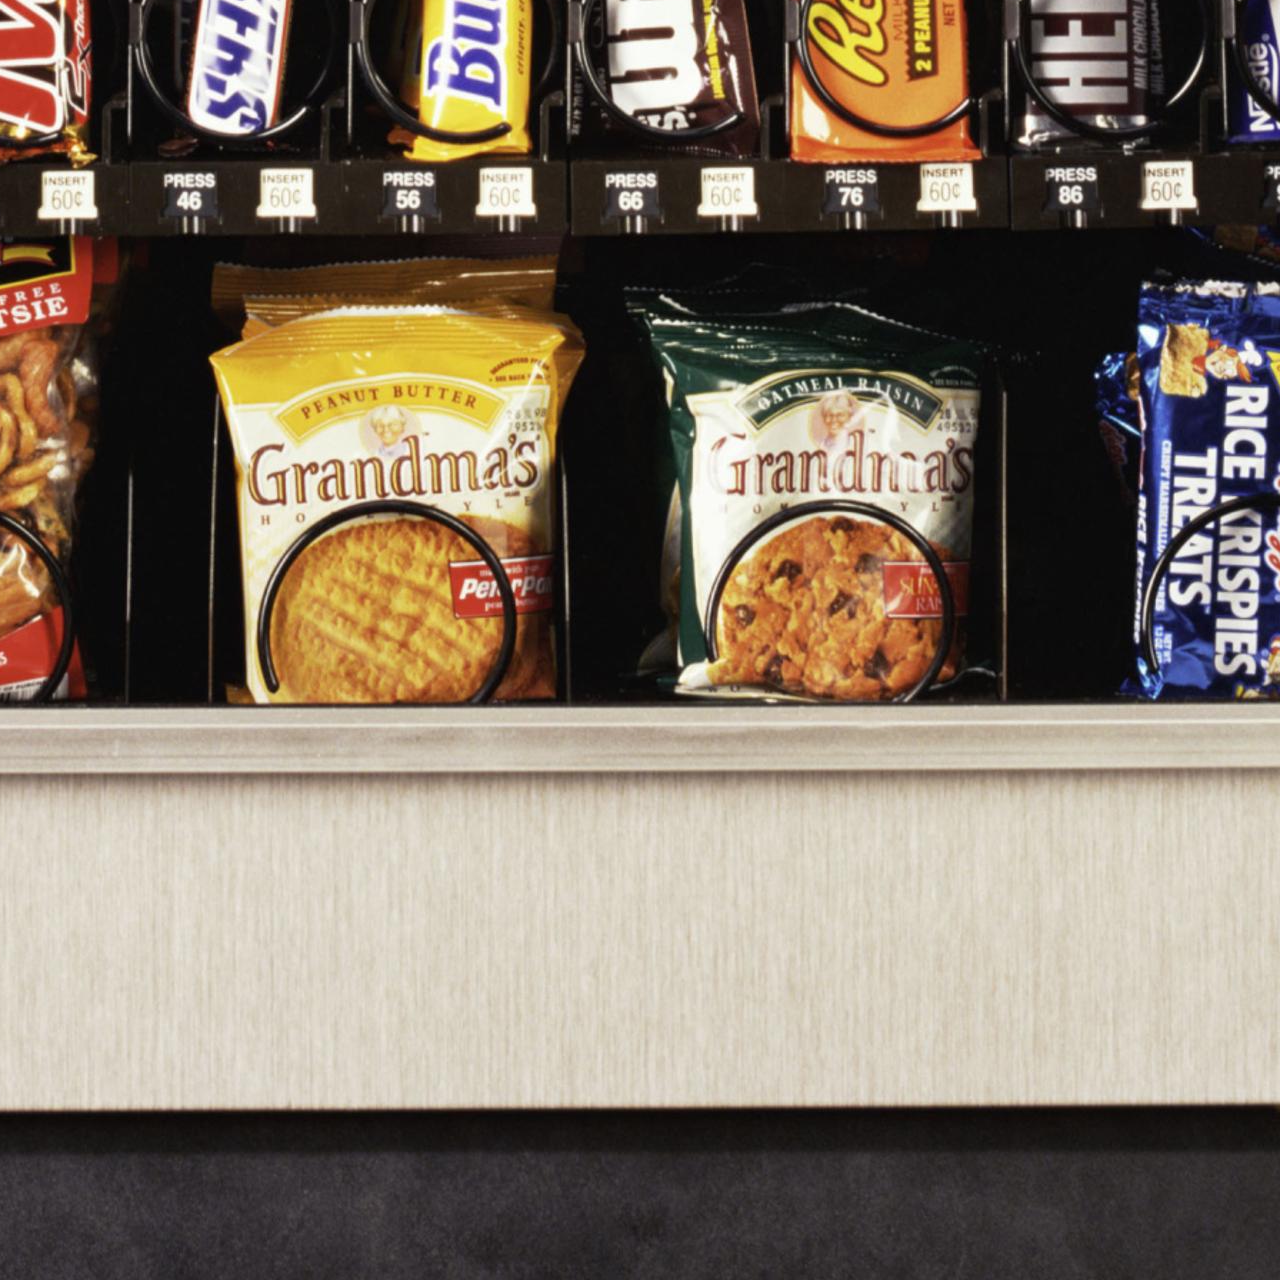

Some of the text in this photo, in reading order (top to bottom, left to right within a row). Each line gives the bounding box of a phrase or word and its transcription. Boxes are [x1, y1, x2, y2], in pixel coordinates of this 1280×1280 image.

[1045, 168, 1096, 182] PRESS
[1059, 186, 1083, 204] 86
[302, 385, 478, 419] PEANUT BUTTER
[758, 377, 925, 410] OATMEAL RAISIN
[248, 434, 538, 506] Grandma's
[1168, 448, 1217, 606] TREATS
[1215, 385, 1268, 675] RICE KRISPIES
